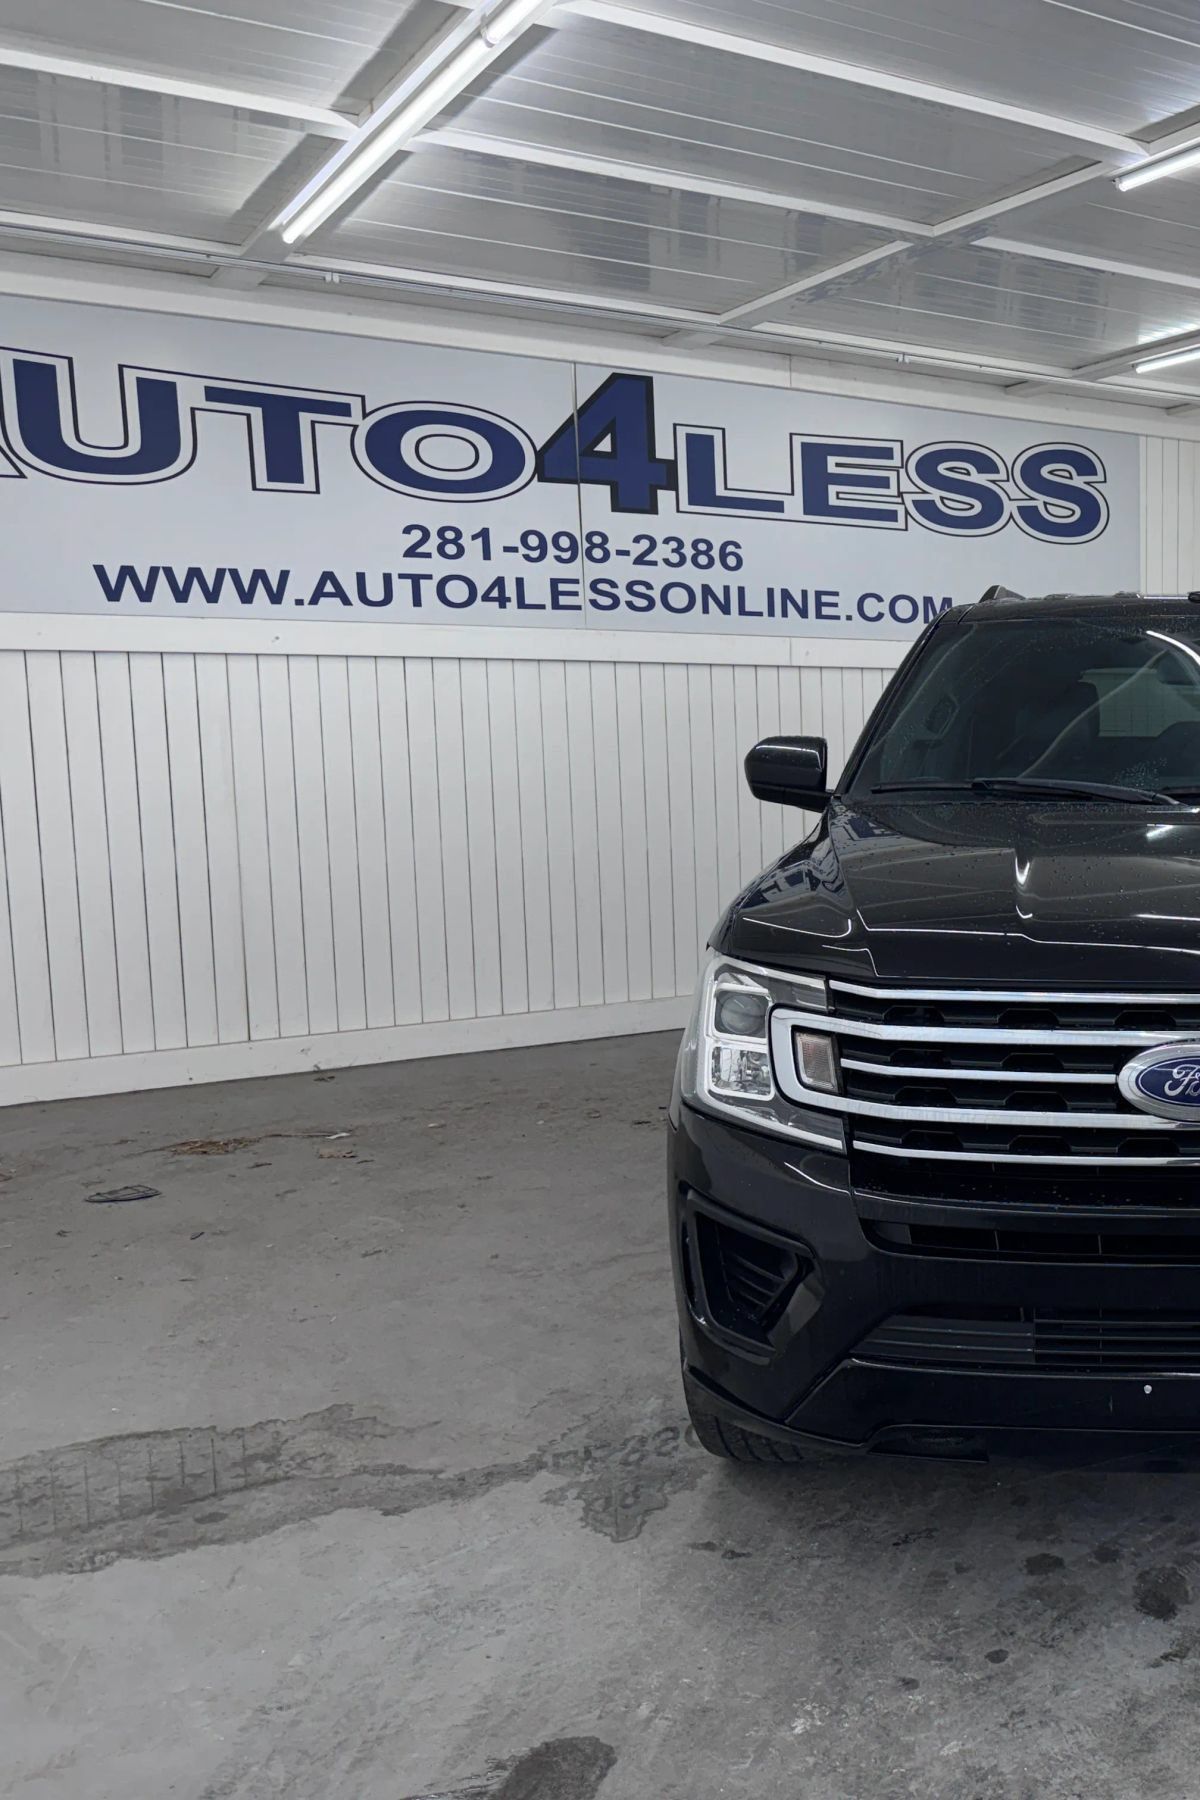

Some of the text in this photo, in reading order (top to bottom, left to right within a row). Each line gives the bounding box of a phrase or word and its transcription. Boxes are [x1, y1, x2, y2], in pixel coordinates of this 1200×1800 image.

[0, 347, 1109, 545] UTO4LESS
[402, 523, 744, 572] 281-998-2386
[93, 564, 952, 624] WWW.AUTO4LESSONLINE.COM
